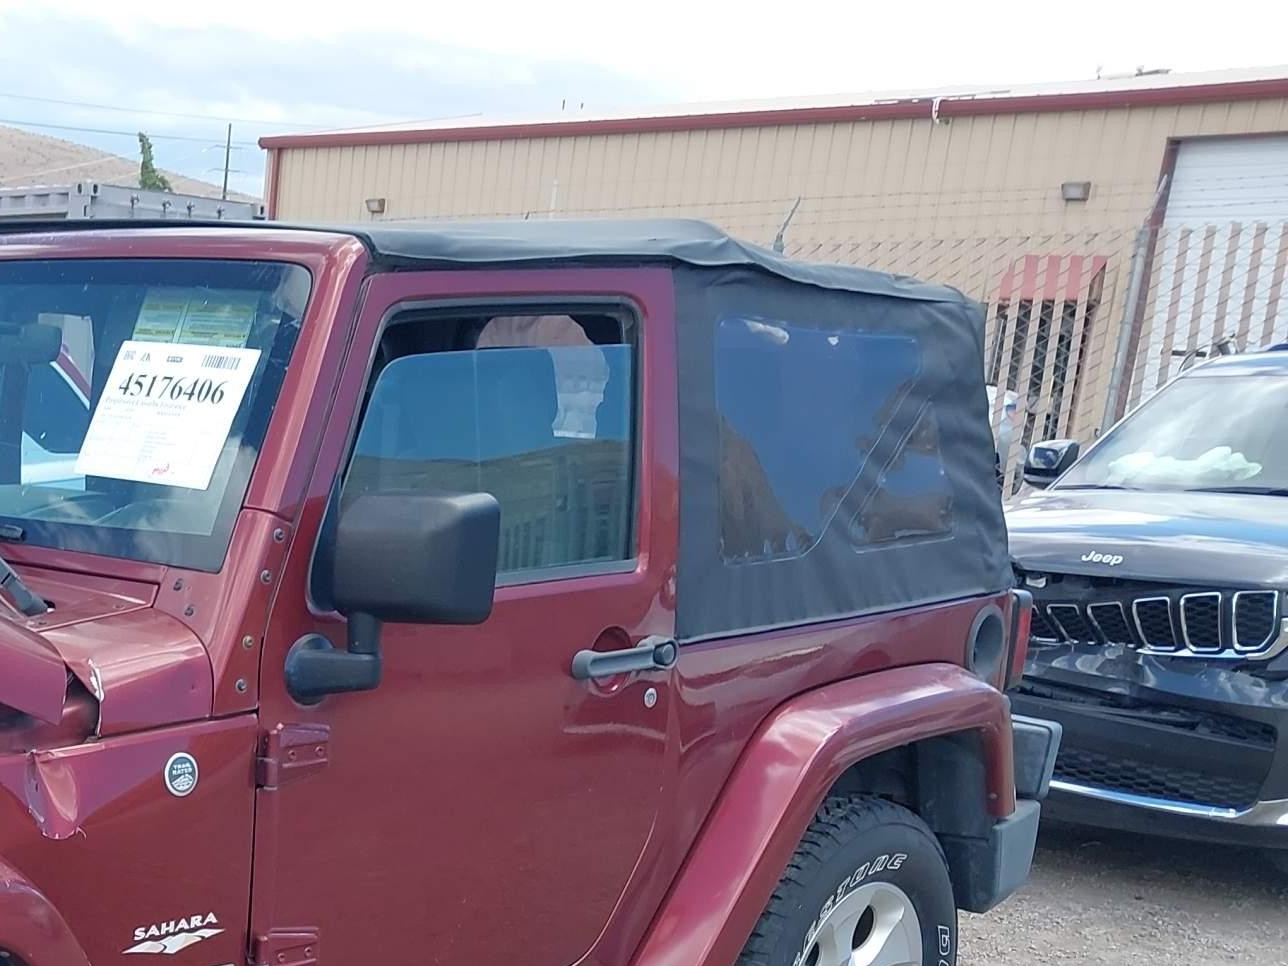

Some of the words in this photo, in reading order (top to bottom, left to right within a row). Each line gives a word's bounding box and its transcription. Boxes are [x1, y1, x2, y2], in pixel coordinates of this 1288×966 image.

[119, 373, 228, 404] 45176406
[1081, 550, 1123, 566] Jeep
[133, 912, 218, 940] SAHARA
